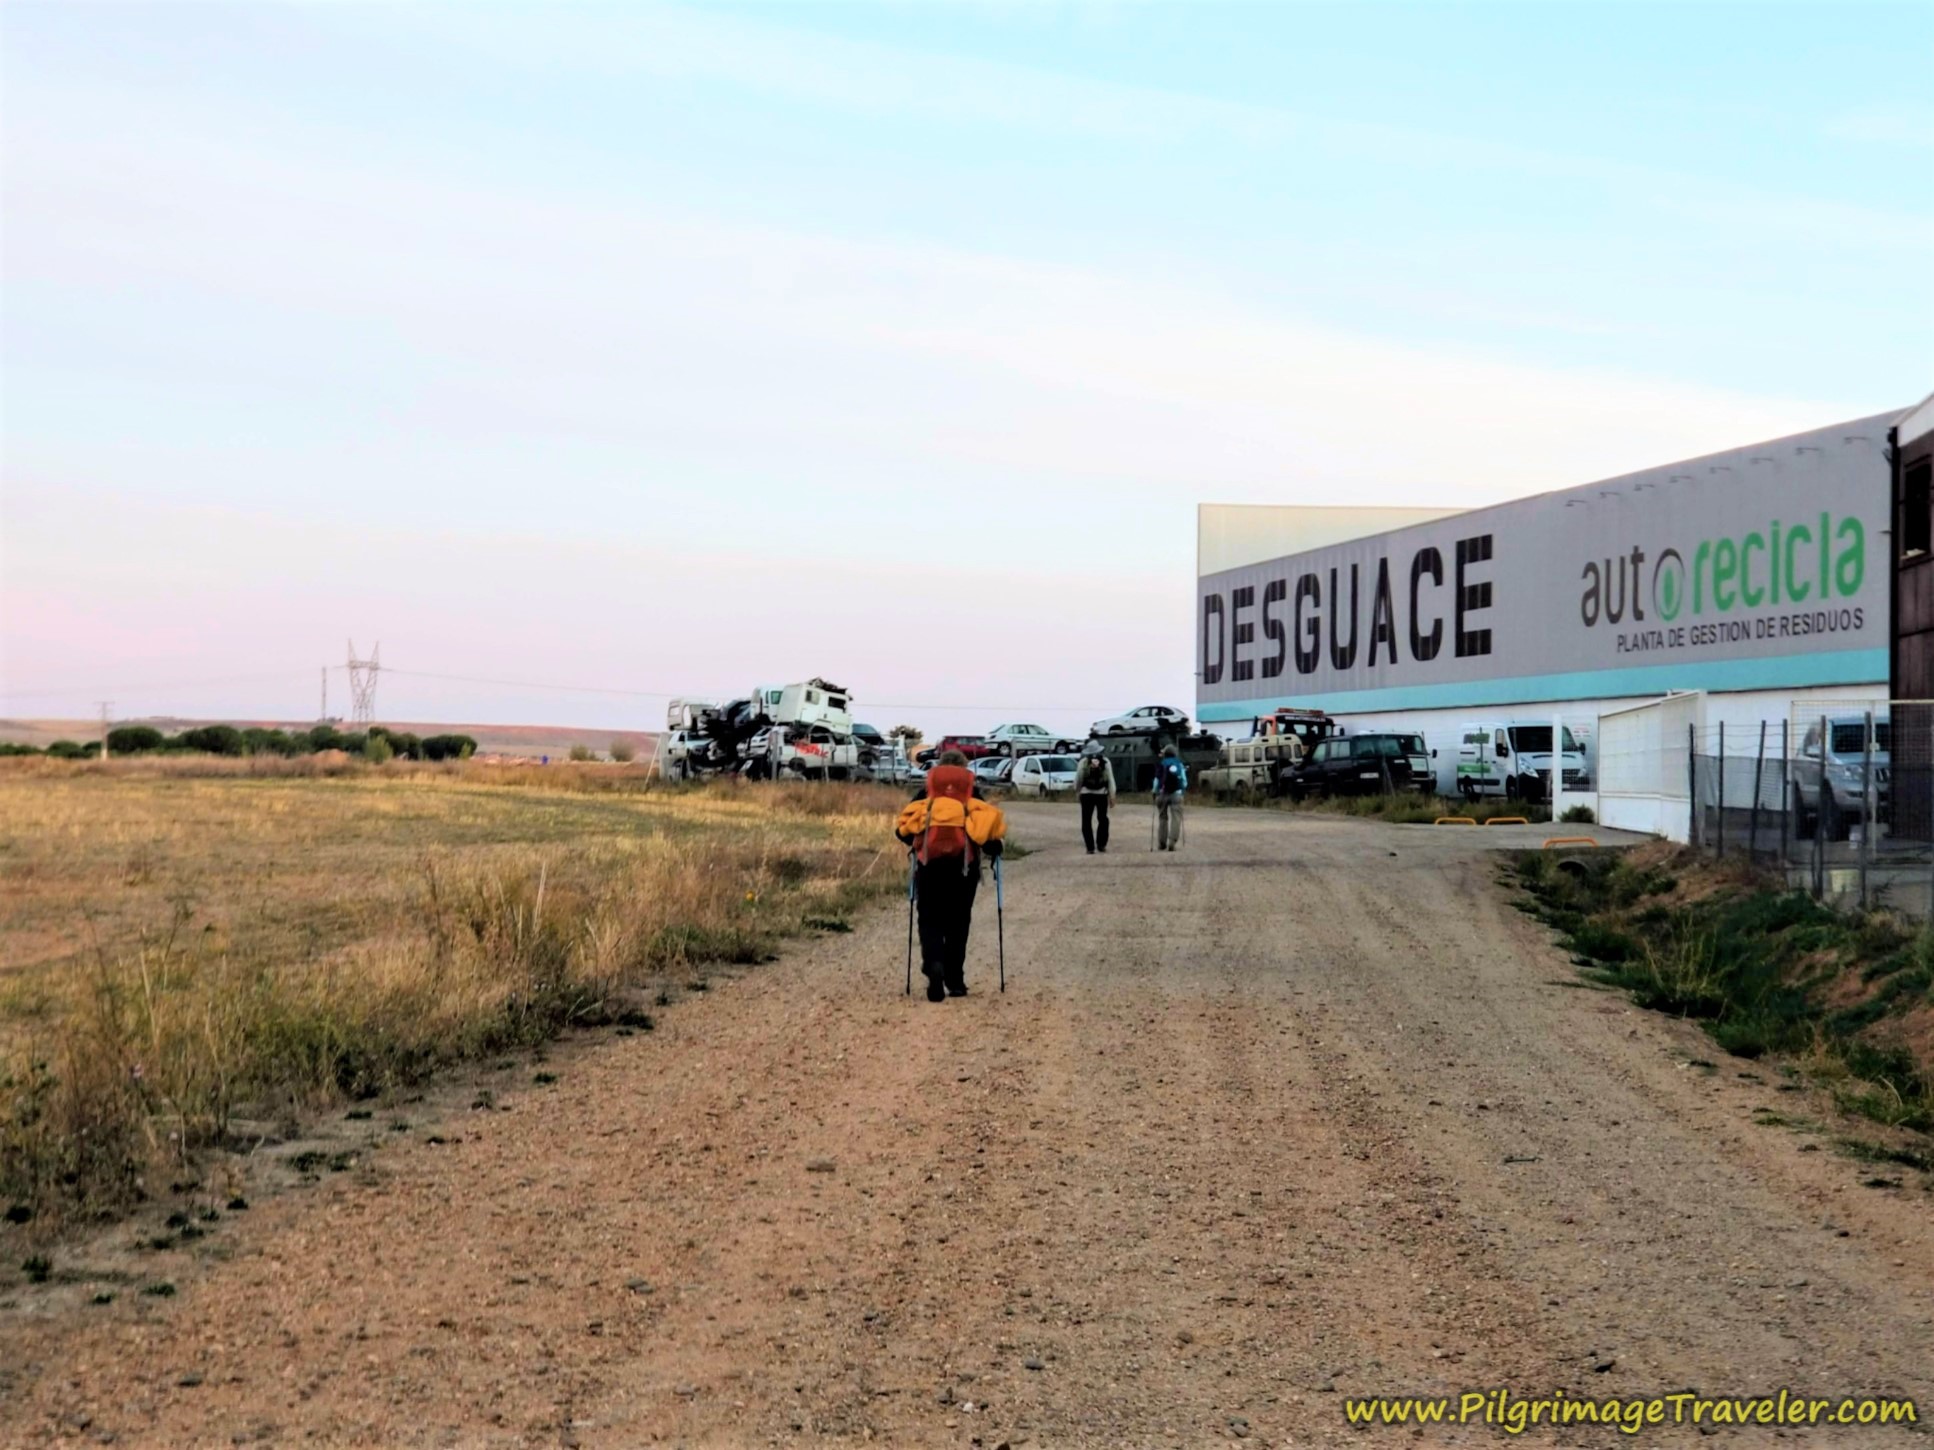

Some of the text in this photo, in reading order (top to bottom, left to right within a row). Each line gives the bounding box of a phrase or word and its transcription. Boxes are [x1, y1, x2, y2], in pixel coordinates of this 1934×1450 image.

[1203, 534, 1493, 685] DESGUACE
[1617, 607, 1864, 653] PLANTA DE GESTION DE RESIDUOS
